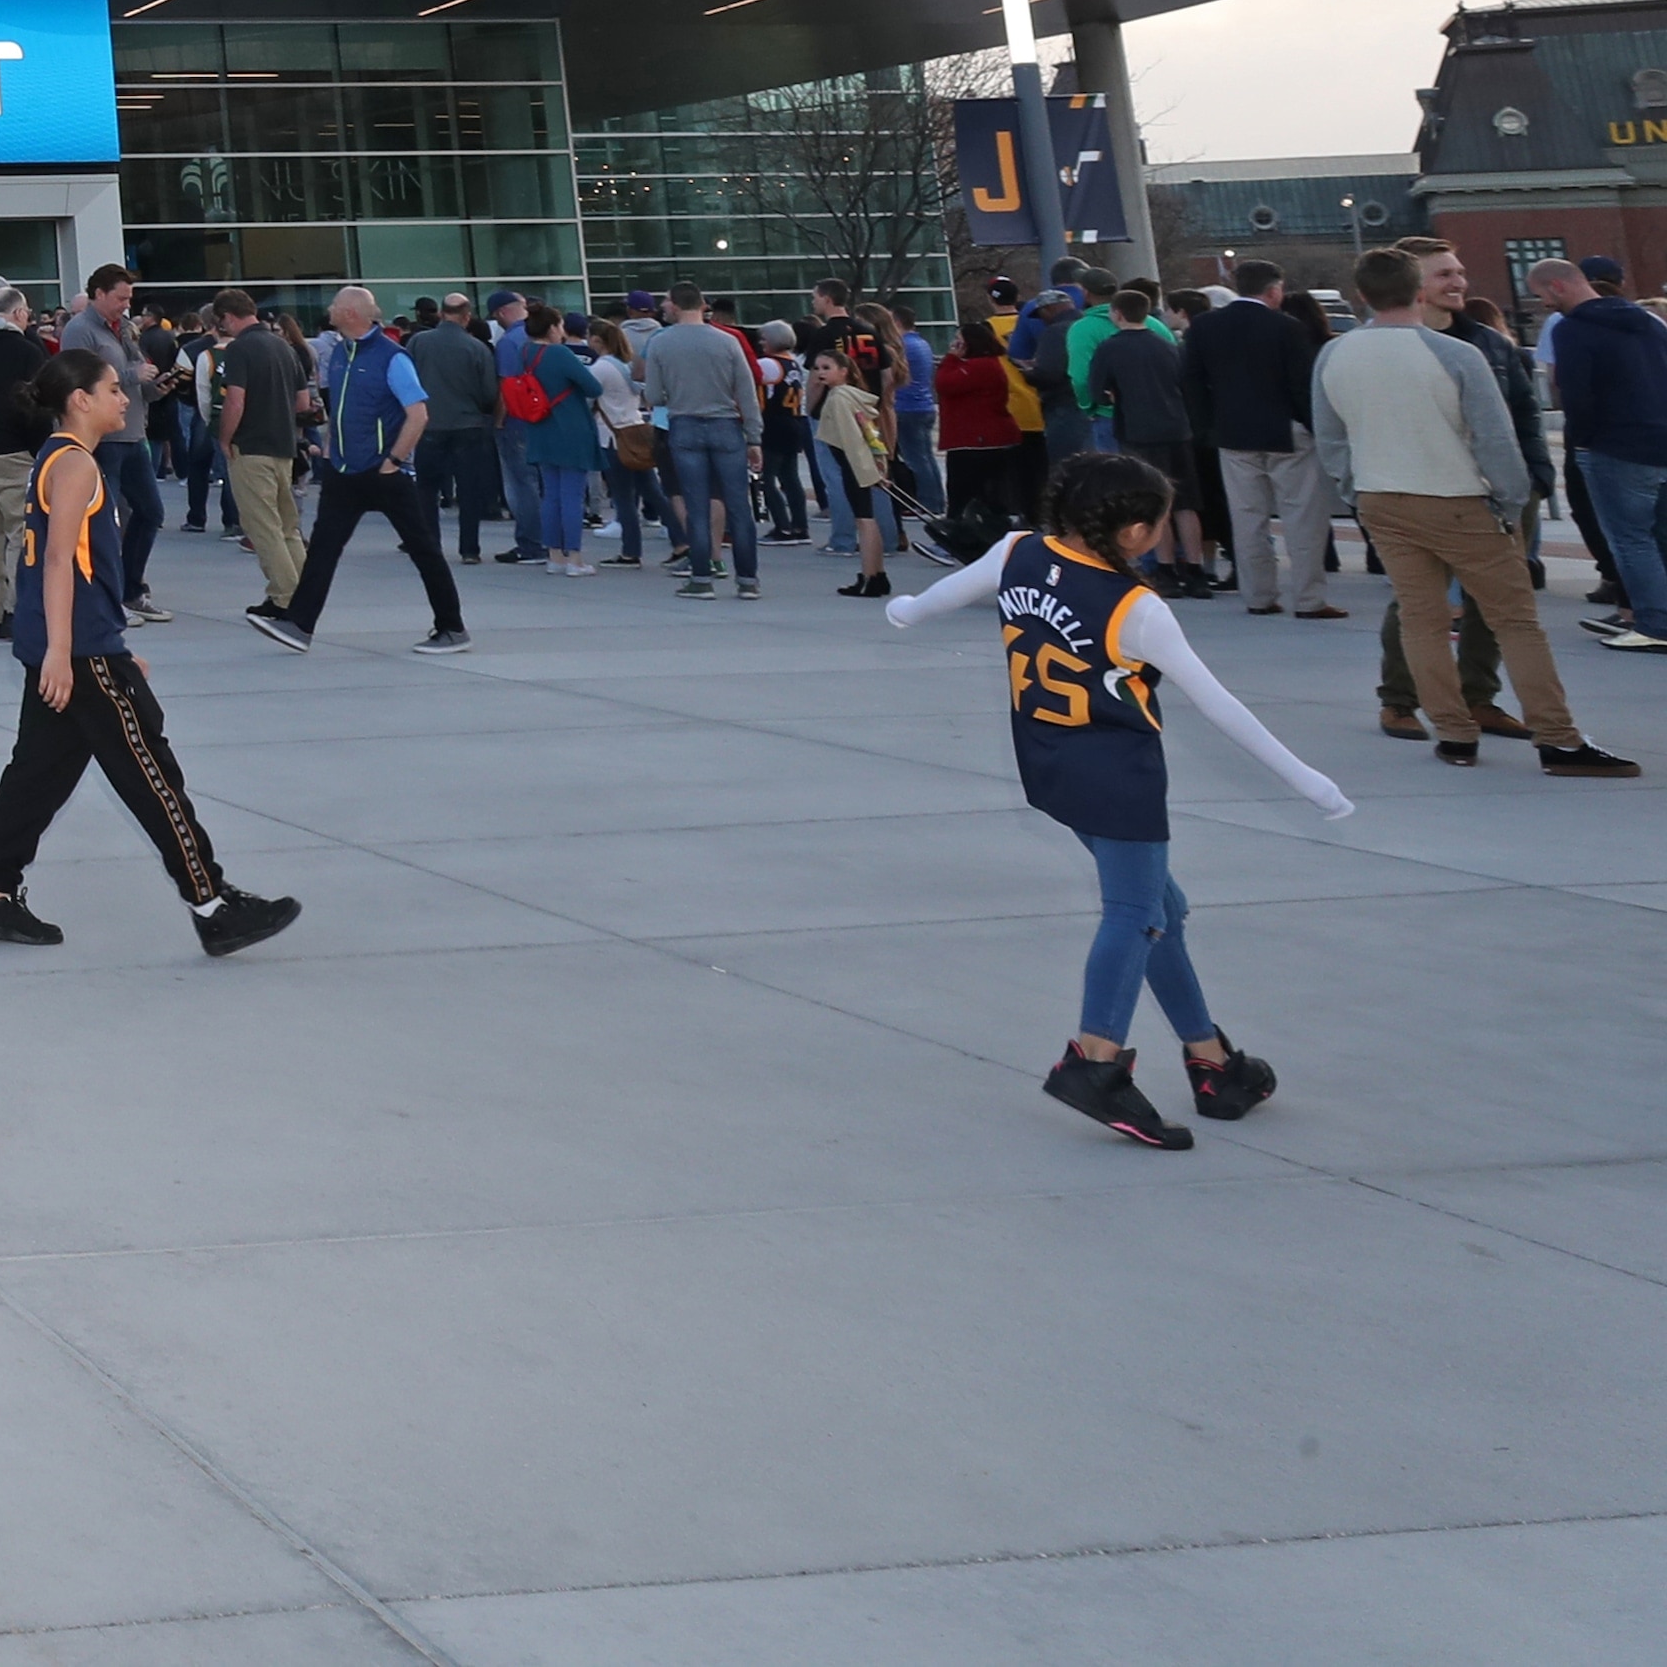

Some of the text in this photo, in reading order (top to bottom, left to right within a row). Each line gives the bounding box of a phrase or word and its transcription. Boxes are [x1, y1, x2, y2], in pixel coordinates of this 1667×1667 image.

[972, 130, 1022, 213] J
[997, 586, 1095, 654] MITCHELL
[1002, 623, 1093, 727] 45
